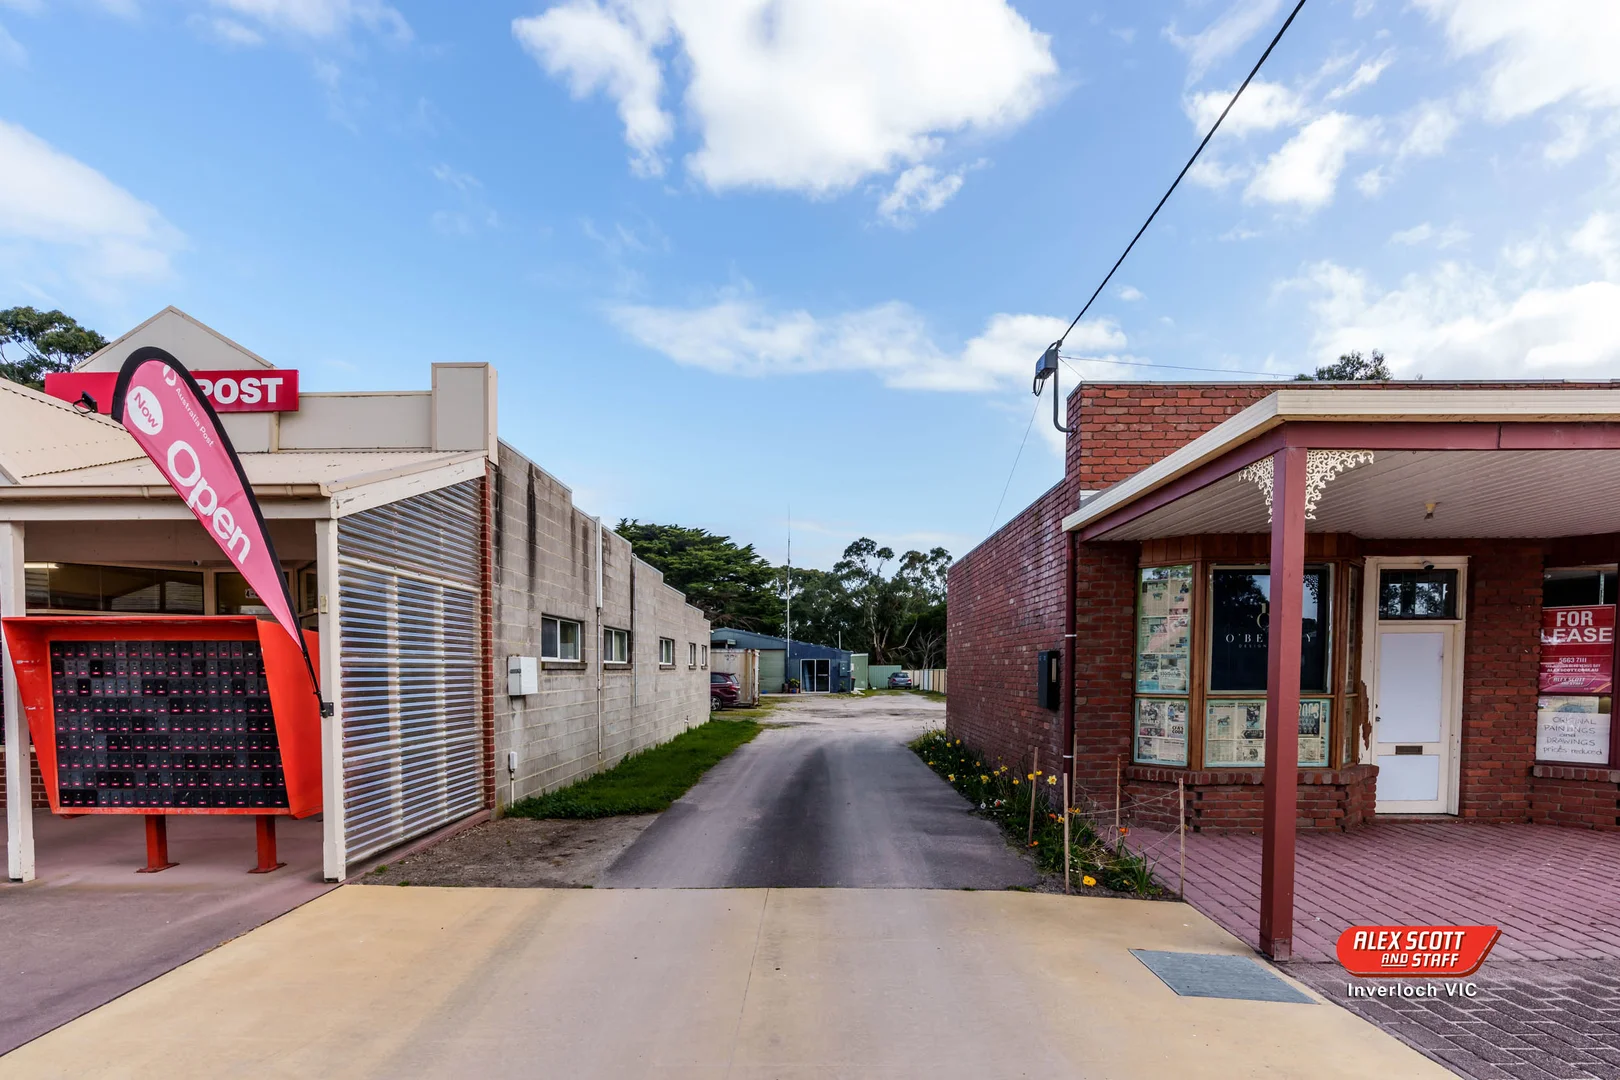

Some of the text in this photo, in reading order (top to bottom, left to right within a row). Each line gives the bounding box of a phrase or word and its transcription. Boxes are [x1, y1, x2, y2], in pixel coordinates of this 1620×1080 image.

[198, 377, 283, 404] POST
[133, 392, 159, 429] Now
[175, 387, 214, 448] Australia Post
[167, 439, 251, 565] Open
[1556, 610, 1593, 627] FOR
[1541, 627, 1613, 643] LEASE
[1546, 736, 1596, 746] DRAWINGS
